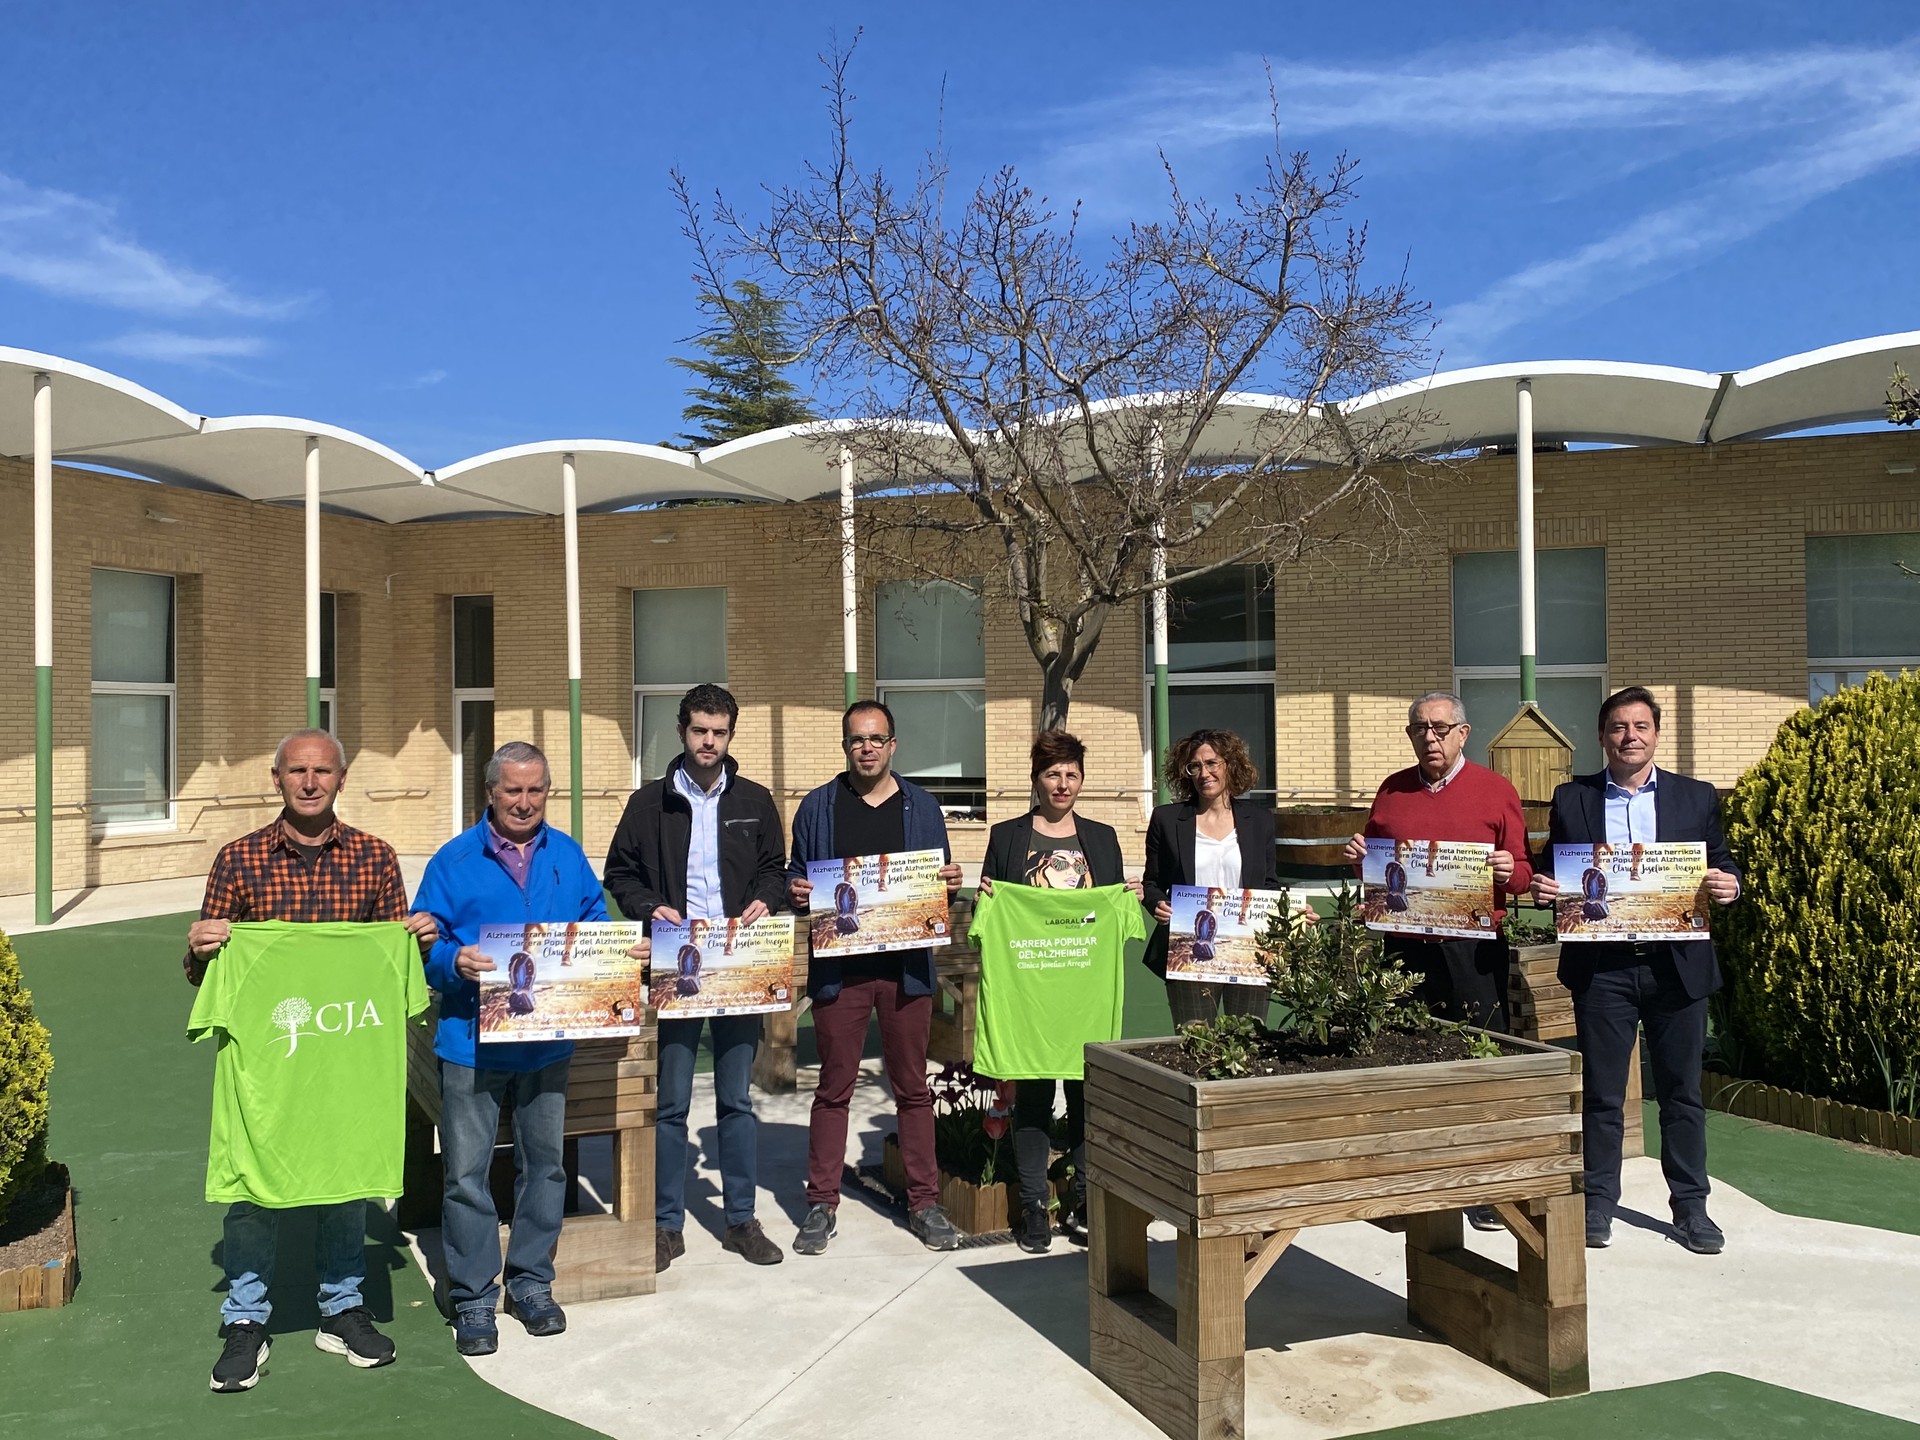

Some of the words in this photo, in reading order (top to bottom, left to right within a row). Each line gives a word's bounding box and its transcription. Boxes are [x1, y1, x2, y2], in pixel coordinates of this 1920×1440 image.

[1367, 844, 1418, 852] Alzheimerraren
[1456, 848, 1489, 856] herrikoia
[1560, 849, 1620, 857] Alzheimerraren
[812, 863, 868, 874] Alzheimerraren
[869, 860, 906, 869] lasterketa
[908, 856, 940, 865] herrikoia
[833, 871, 860, 879] Carrera
[862, 869, 889, 877] Popular
[905, 864, 940, 872] Alzheimer
[1177, 891, 1231, 900] Alzheimerraren
[1045, 918, 1080, 926] LABORAL
[486, 930, 552, 940] Alzheimerraren
[554, 929, 598, 938] lasterketa
[600, 928, 637, 937] herrikoia
[657, 925, 715, 933] Alzheimerraren
[709, 932, 737, 940] Popular
[510, 939, 542, 947] Carrera
[544, 939, 577, 948] Popular
[580, 938, 593, 946] del
[595, 937, 637, 946] Alzheimer
[1009, 939, 1053, 949] CARRERA
[1054, 937, 1097, 947] POPULAR
[1018, 951, 1036, 960] DEL
[1038, 948, 1088, 959] ALZHEIMER
[1067, 959, 1092, 969] Arregui
[316, 999, 384, 1036] CJA
